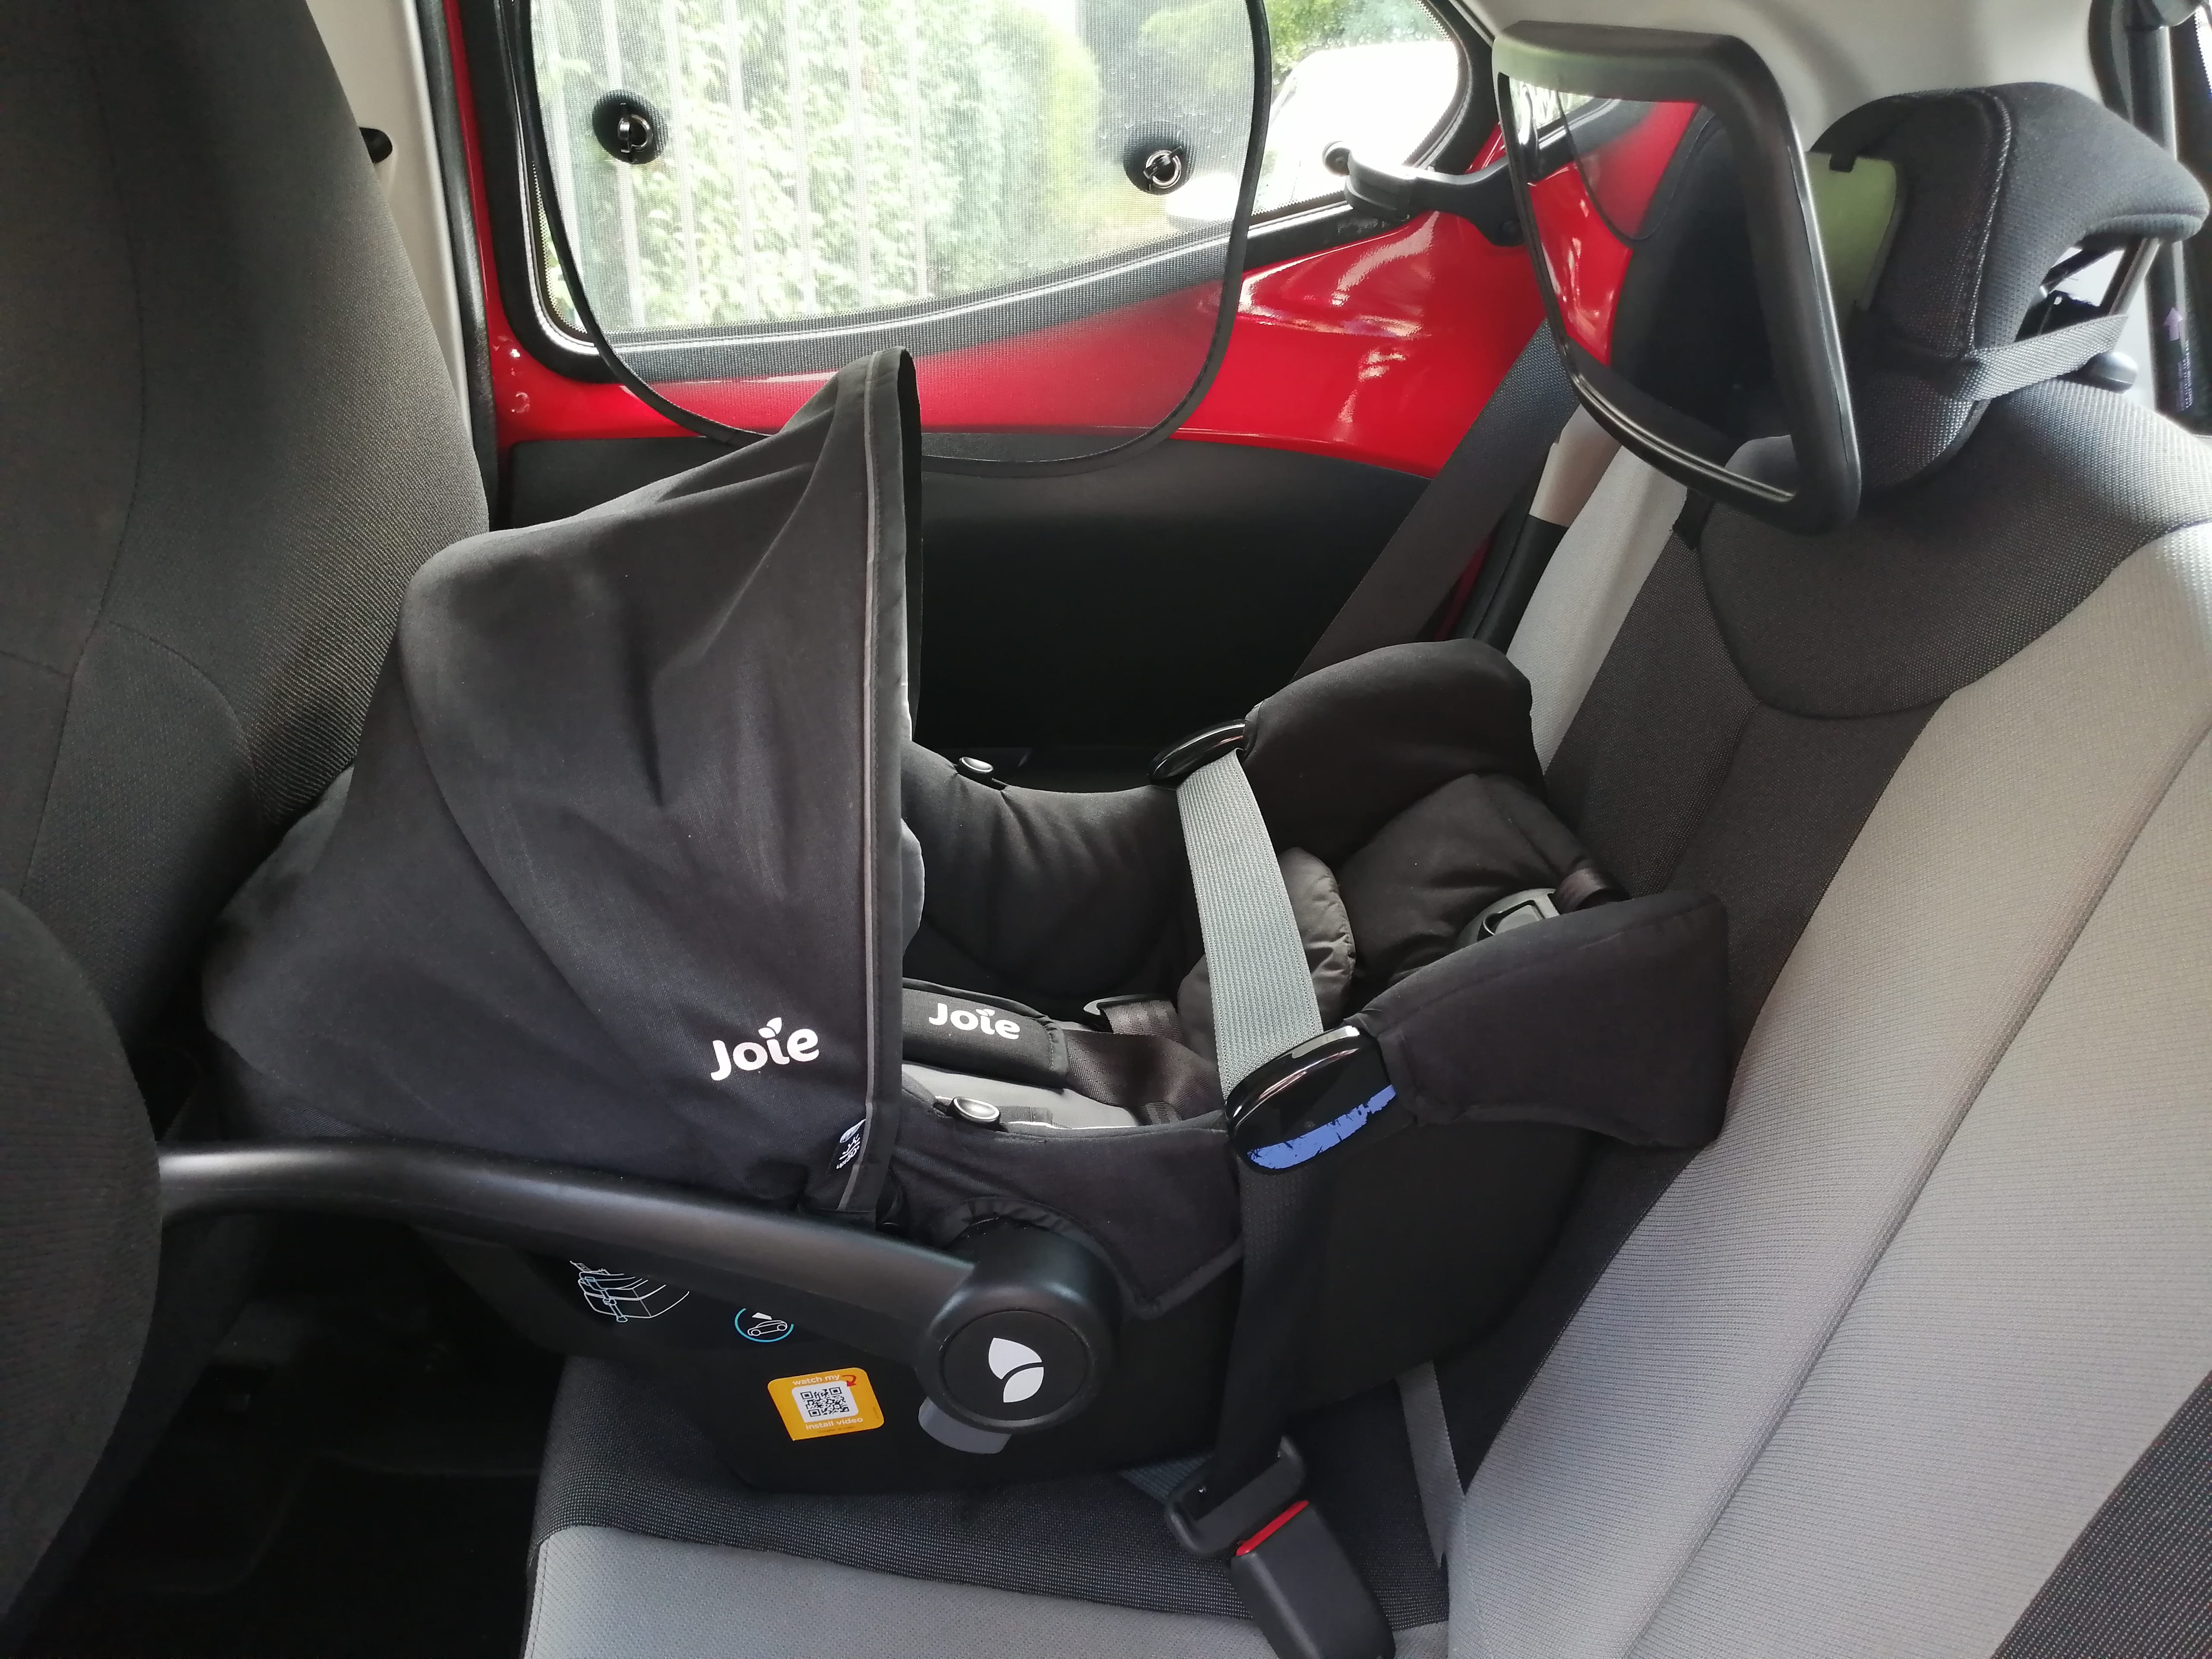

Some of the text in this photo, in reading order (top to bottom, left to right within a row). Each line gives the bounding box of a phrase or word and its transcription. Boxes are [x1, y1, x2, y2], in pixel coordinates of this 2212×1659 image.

[928, 1002, 1021, 1040] Joie
[710, 1017, 820, 1081] Joie
[792, 1374, 840, 1386] watch my
[805, 1421, 834, 1430] install
[836, 1417, 864, 1425] video
